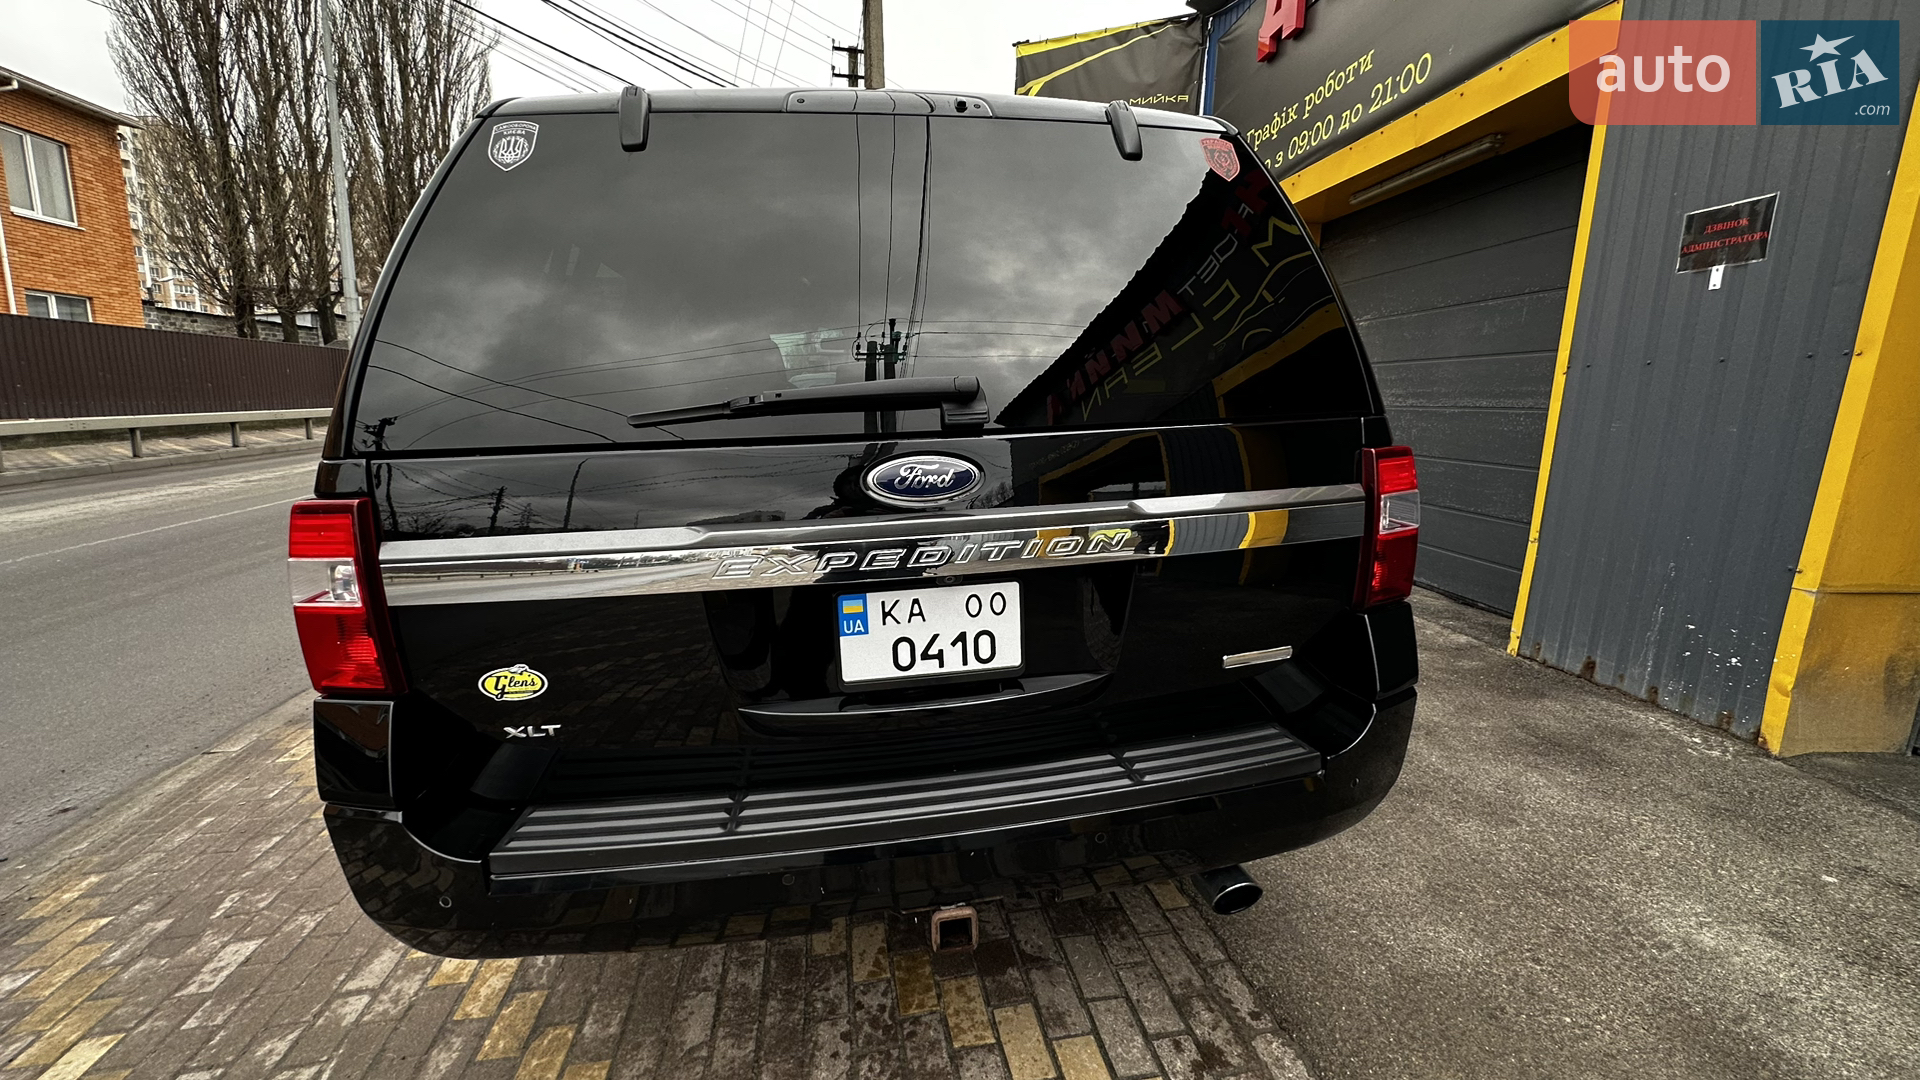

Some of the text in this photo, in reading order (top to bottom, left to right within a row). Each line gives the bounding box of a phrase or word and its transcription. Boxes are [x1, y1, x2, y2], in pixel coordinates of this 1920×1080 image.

[1129, 93, 1189, 106] МИЙКА
[1246, 48, 1375, 152] Графік роботи
[1287, 114, 1335, 160] 09:00
[1337, 103, 1363, 135] до
[1368, 52, 1432, 114] 21:00
[1703, 217, 1750, 235] ДЗВІНОК
[1681, 231, 1769, 254] АДМІНІСТРАТОРА
[894, 463, 955, 490] Ford
[713, 529, 1131, 578] EXPEDITION
[880, 597, 926, 626] KA
[843, 619, 865, 634] UA
[891, 629, 997, 672] 0410
[502, 723, 562, 740] XLT
